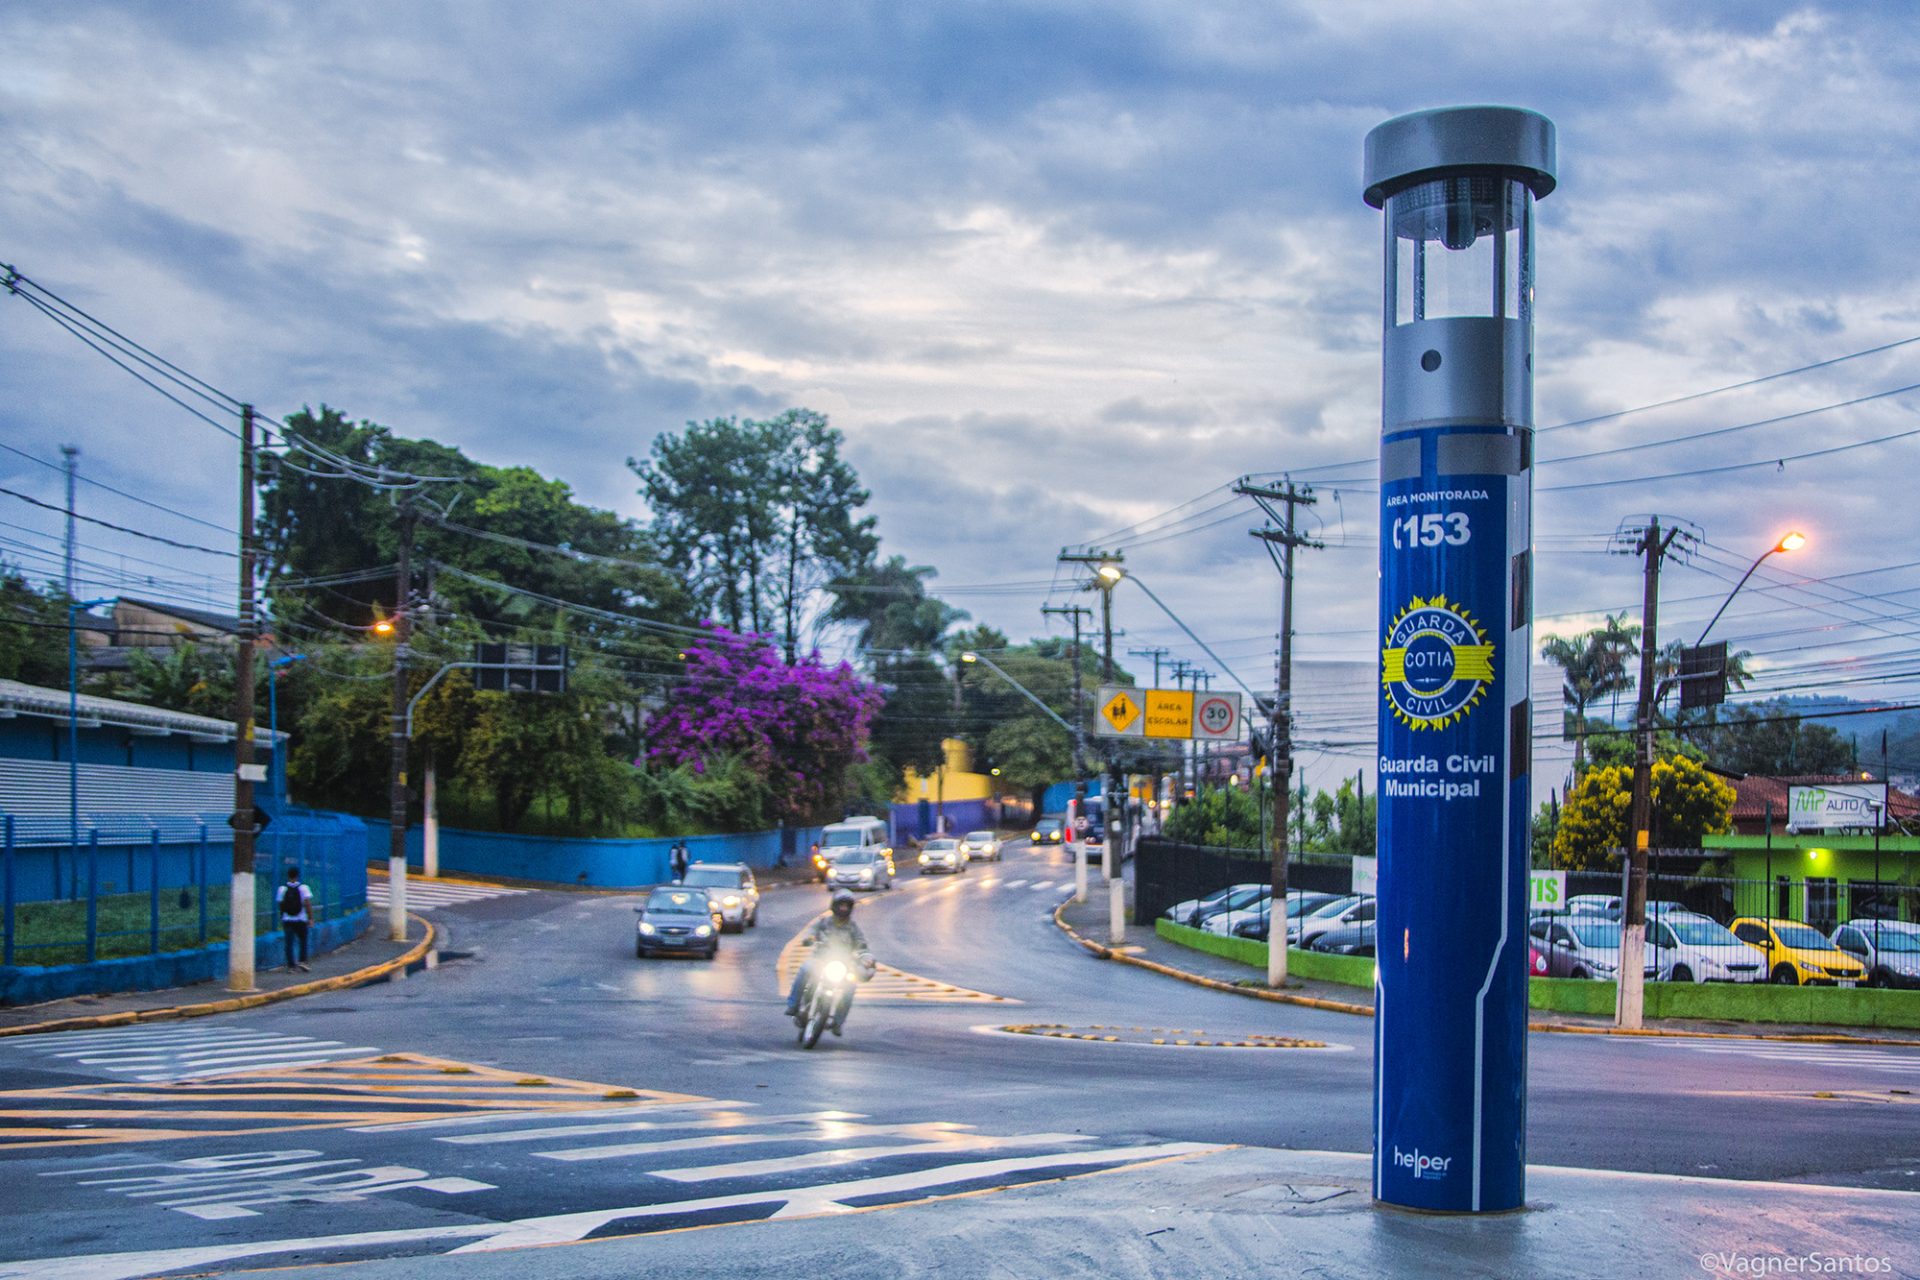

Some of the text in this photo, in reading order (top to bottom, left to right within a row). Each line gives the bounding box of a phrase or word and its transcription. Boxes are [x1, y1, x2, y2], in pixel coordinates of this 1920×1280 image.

[1386, 489, 1489, 507] ÁREA MONITORADA
[1396, 614, 1466, 644] GUARDA
[1405, 651, 1454, 668] COTIA
[1206, 707, 1227, 719] 30
[1406, 697, 1453, 713] CIVIL
[1380, 755, 1495, 773] Guarda Civil
[1386, 779, 1480, 801] Municipal
[1795, 789, 1859, 812] MP AUTO
[1394, 1145, 1452, 1178] helper
